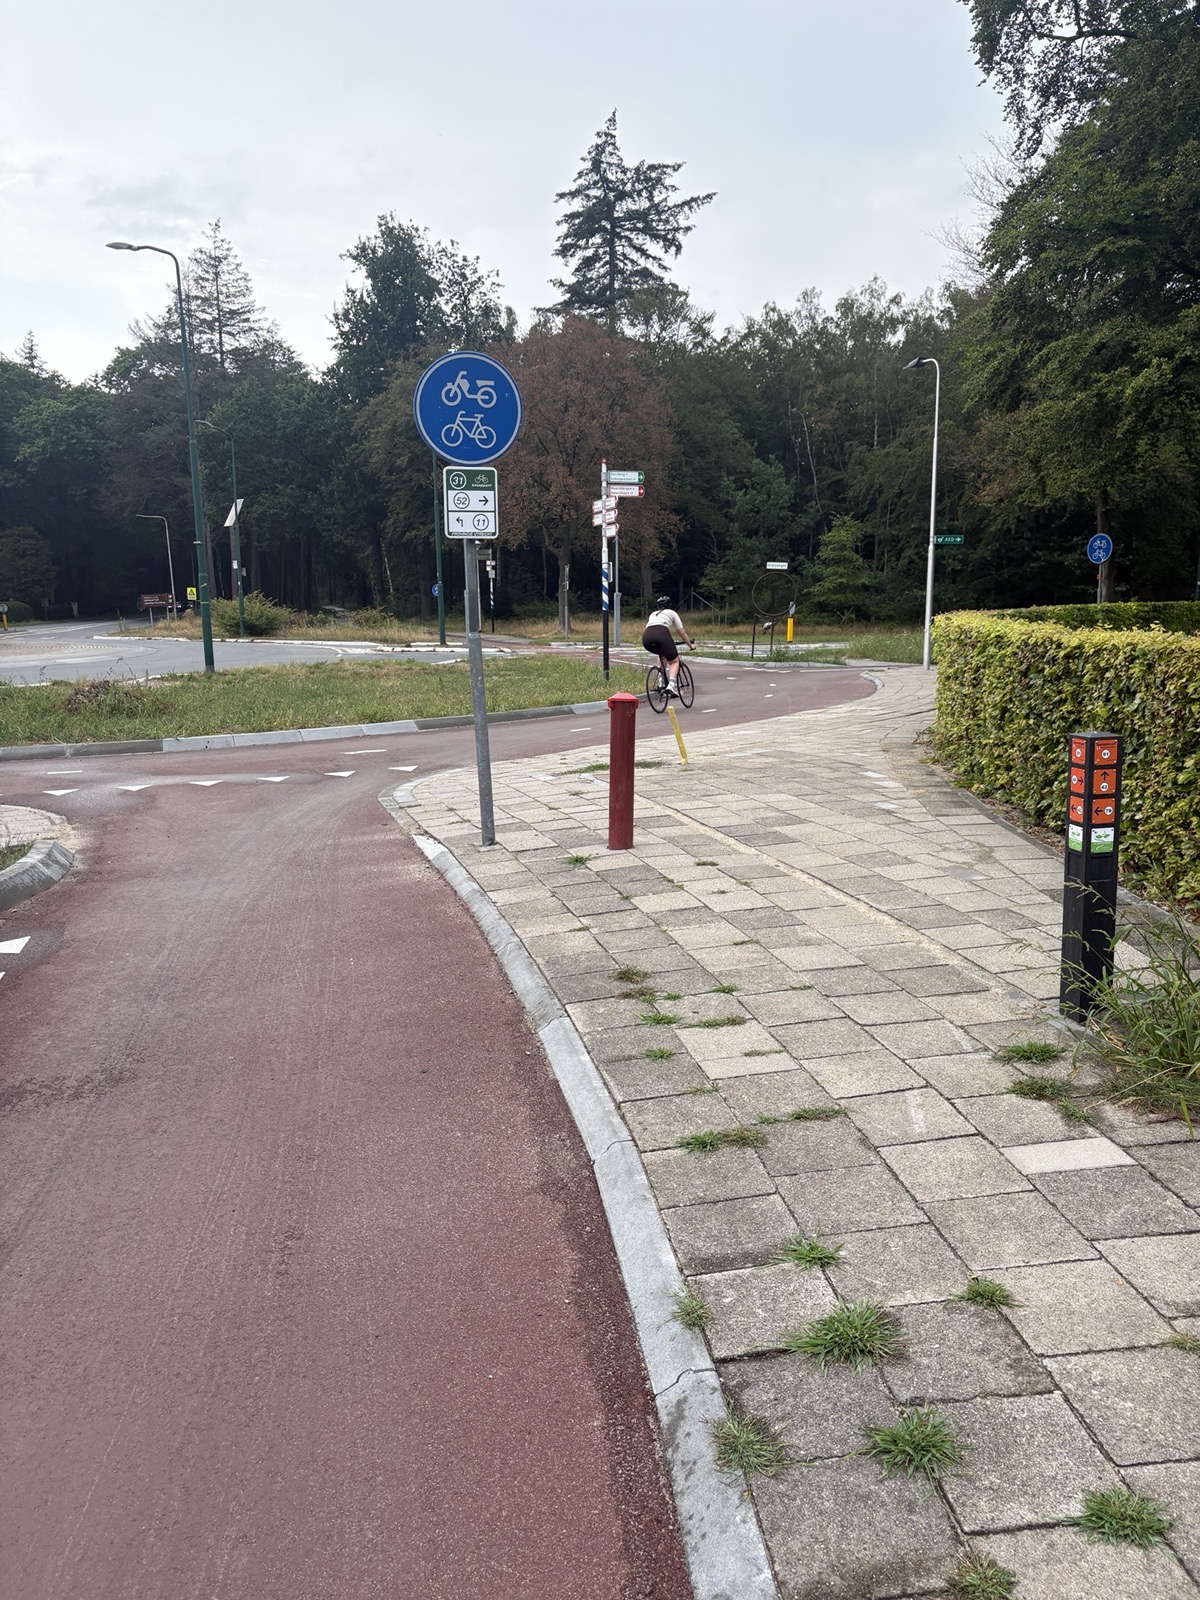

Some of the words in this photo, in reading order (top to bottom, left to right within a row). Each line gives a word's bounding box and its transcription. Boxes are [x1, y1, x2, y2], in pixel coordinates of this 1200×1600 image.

[452, 476, 464, 485] 31
[456, 496, 468, 505] 52
[476, 518, 486, 527] 11
